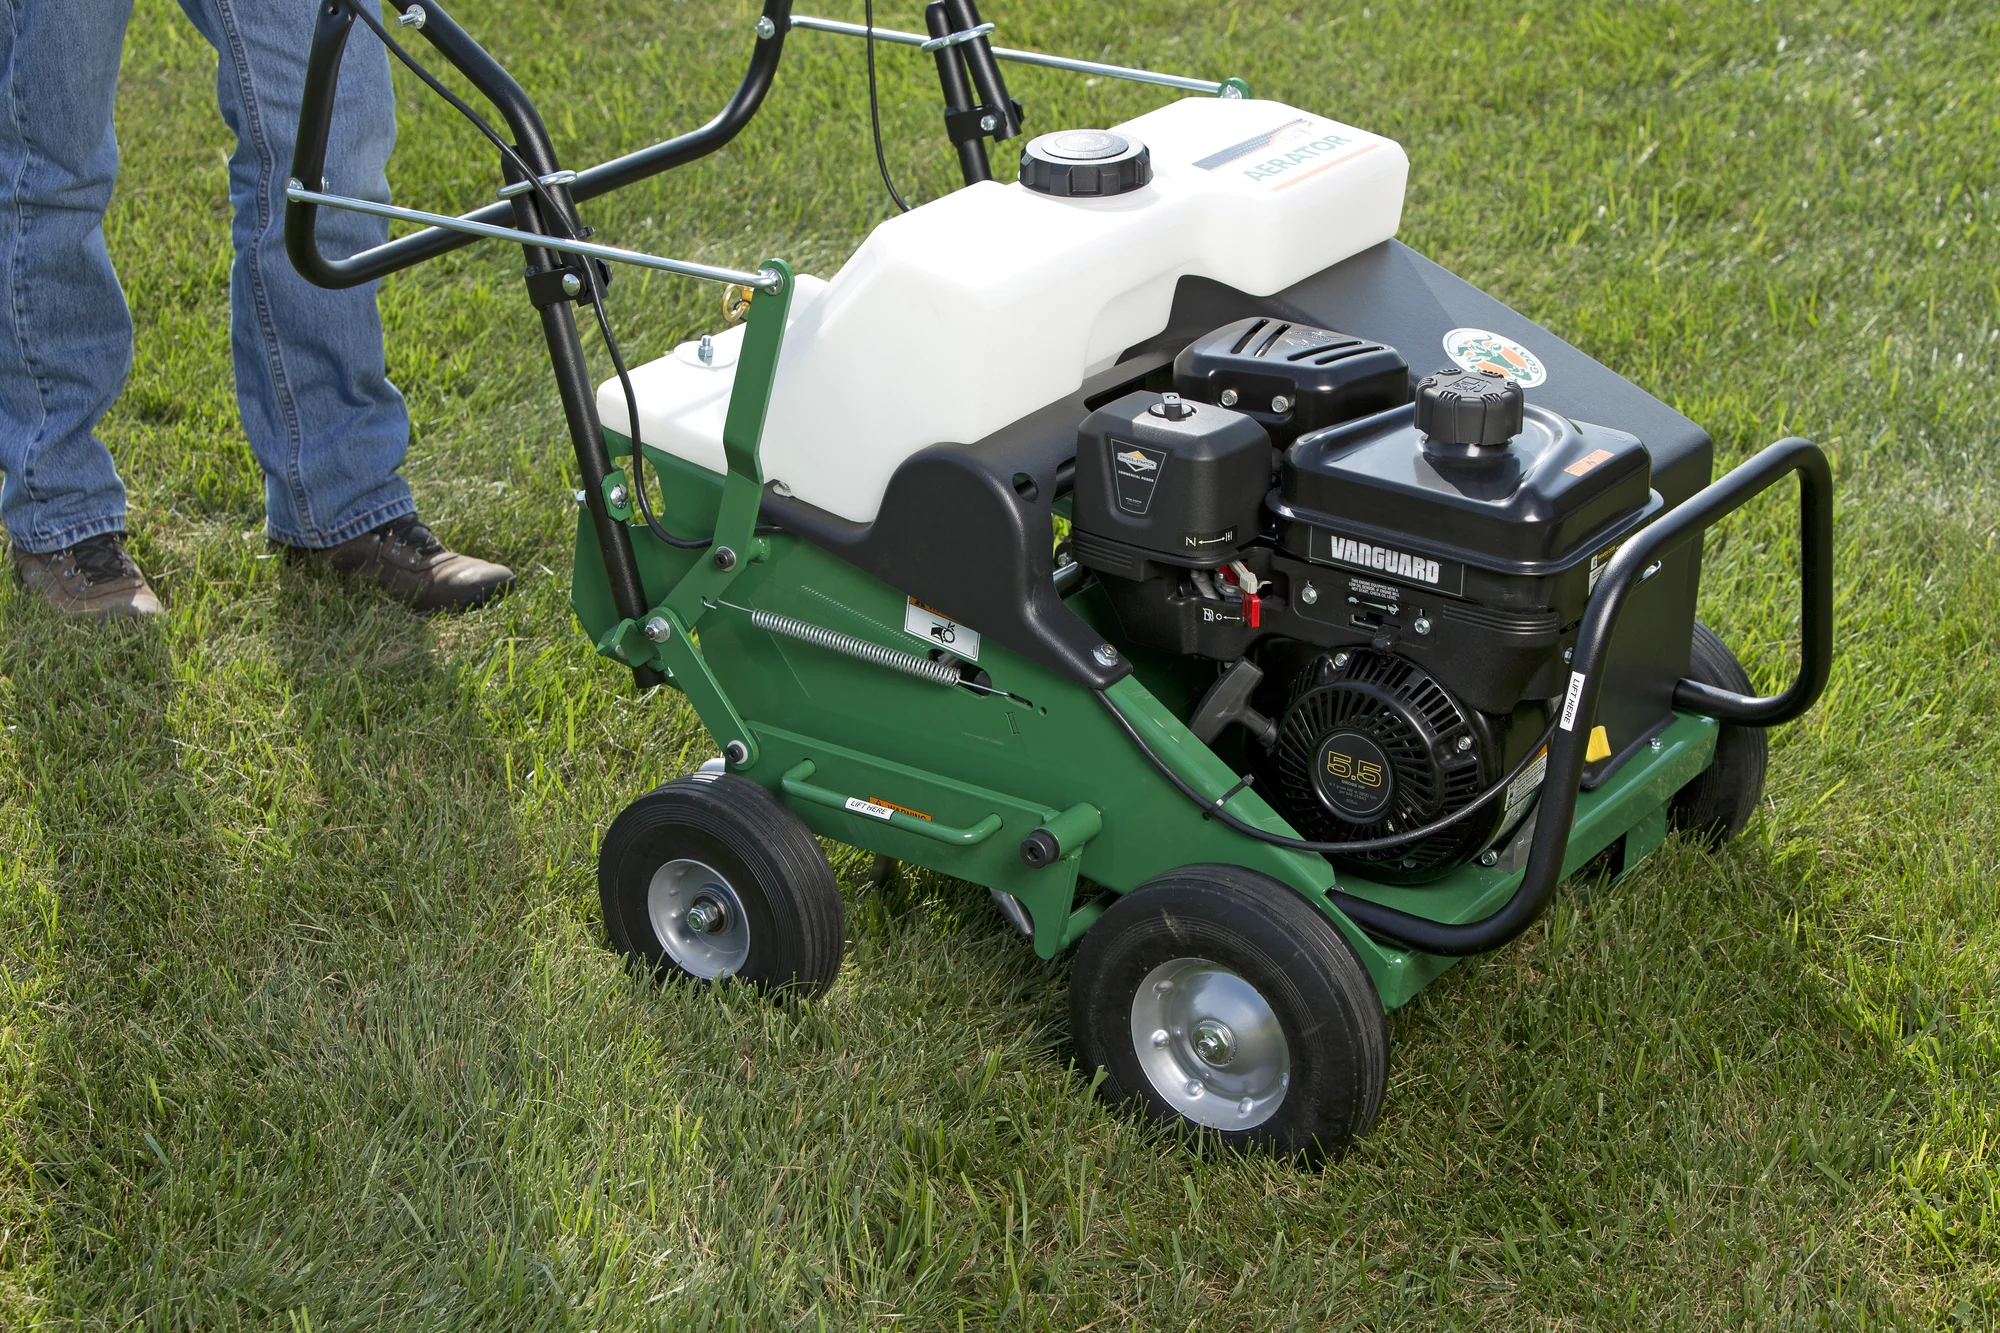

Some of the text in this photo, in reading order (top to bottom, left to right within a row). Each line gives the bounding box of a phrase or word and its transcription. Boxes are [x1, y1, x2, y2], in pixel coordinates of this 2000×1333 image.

[1243, 135, 1352, 181] AERATOR
[1507, 345, 1539, 374] GOAT
[1331, 535, 1439, 584] VANGUARD
[1563, 678, 1580, 724] LIFT HERE
[1327, 750, 1381, 787] 5.5
[850, 800, 887, 815] LIFT HERE
